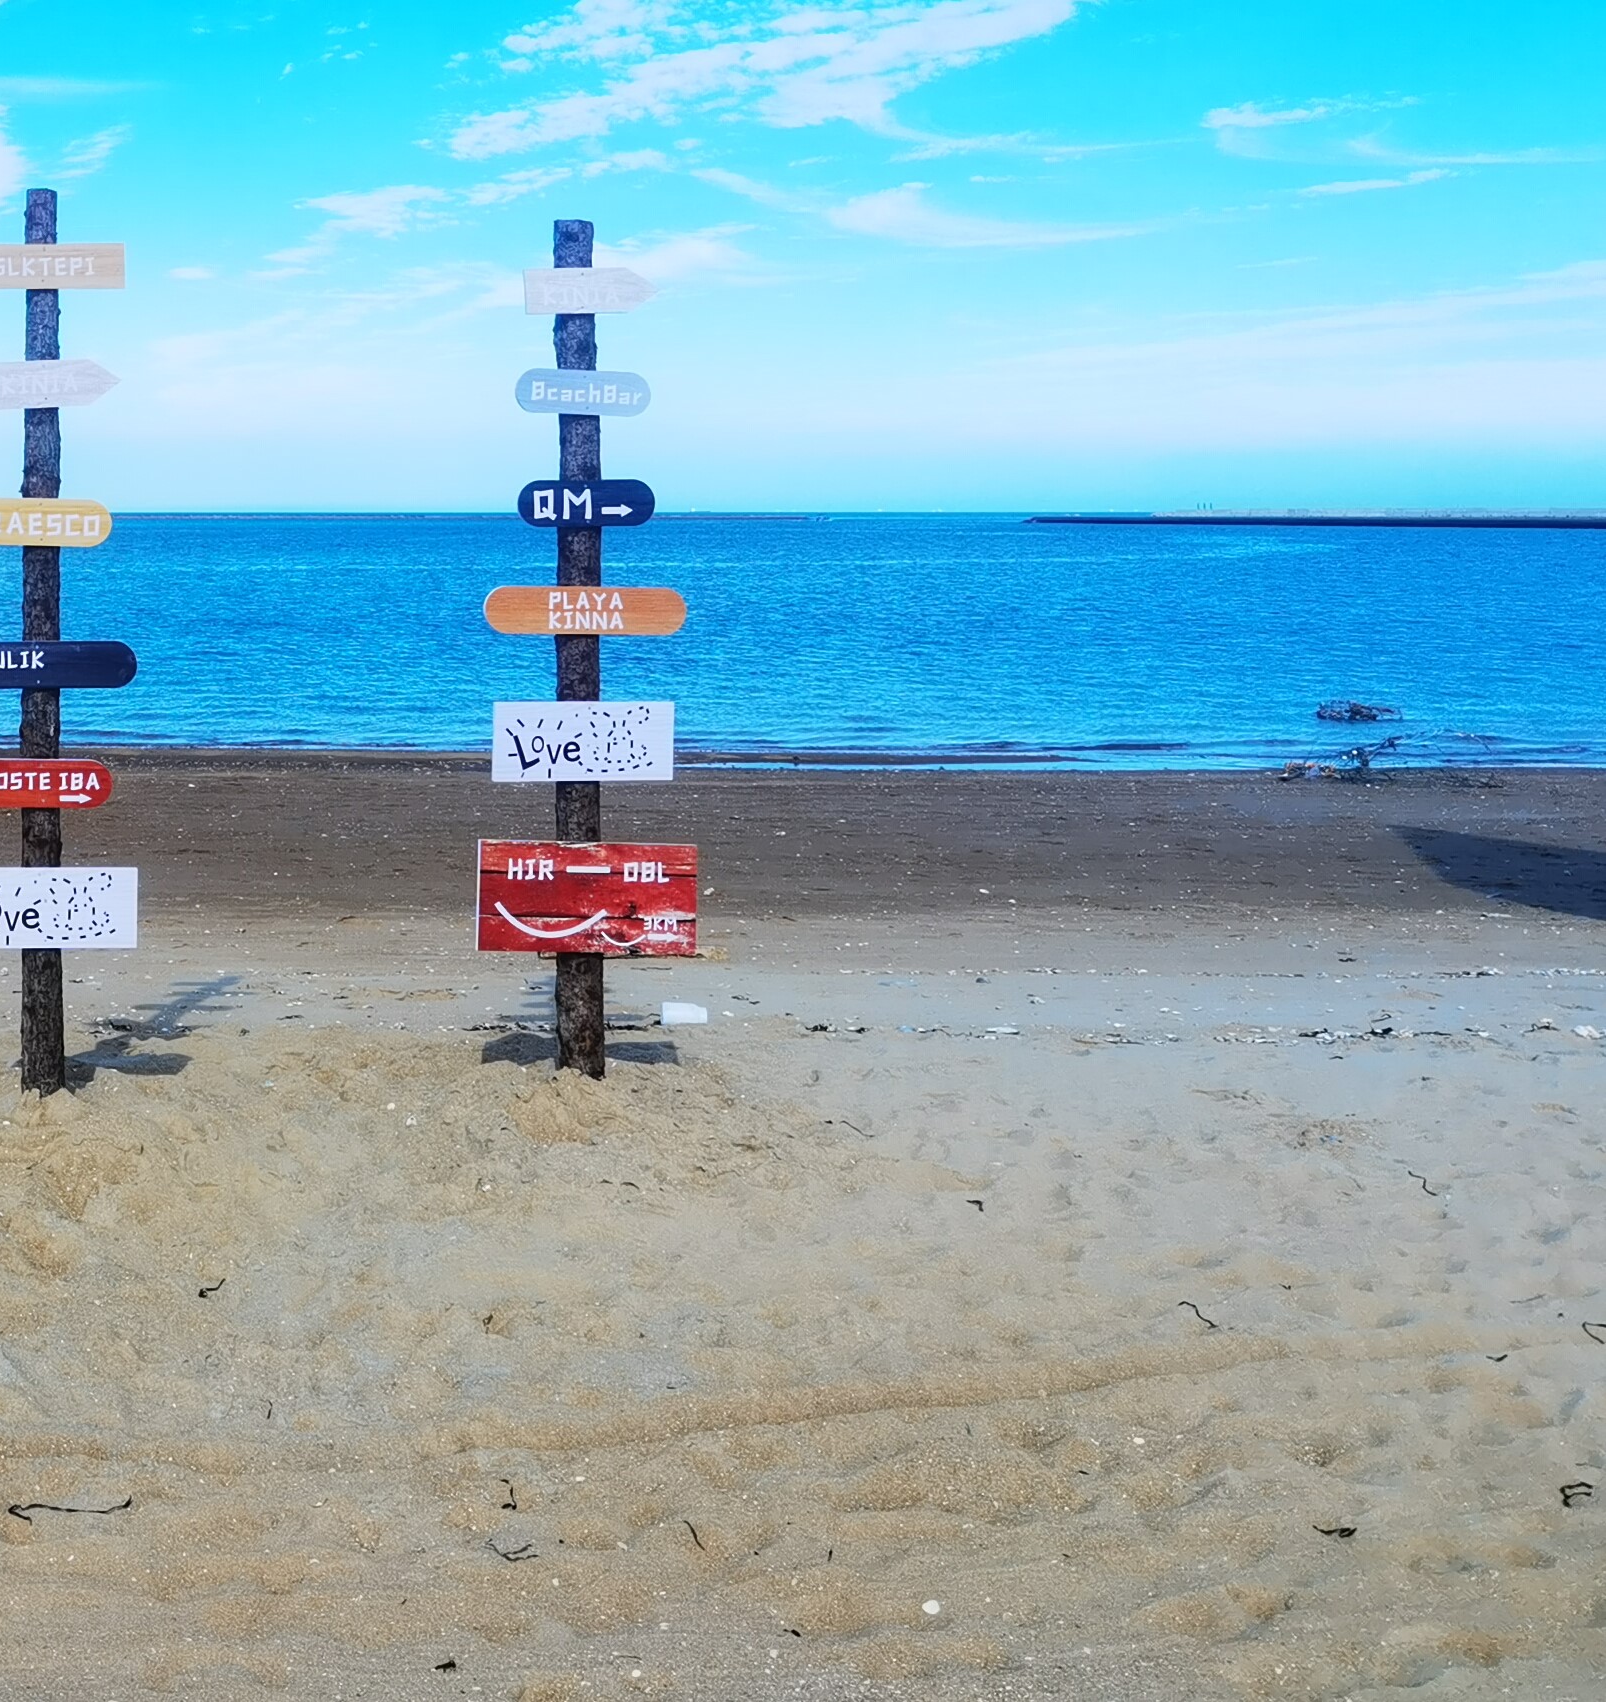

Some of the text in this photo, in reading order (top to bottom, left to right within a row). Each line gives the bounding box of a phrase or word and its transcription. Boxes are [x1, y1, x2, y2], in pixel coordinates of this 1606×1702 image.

[533, 489, 592, 520] QM
[548, 591, 623, 609] PLAYA
[548, 611, 623, 630] KINNA
[58, 773, 100, 791] IBA
[507, 858, 554, 880] HIR
